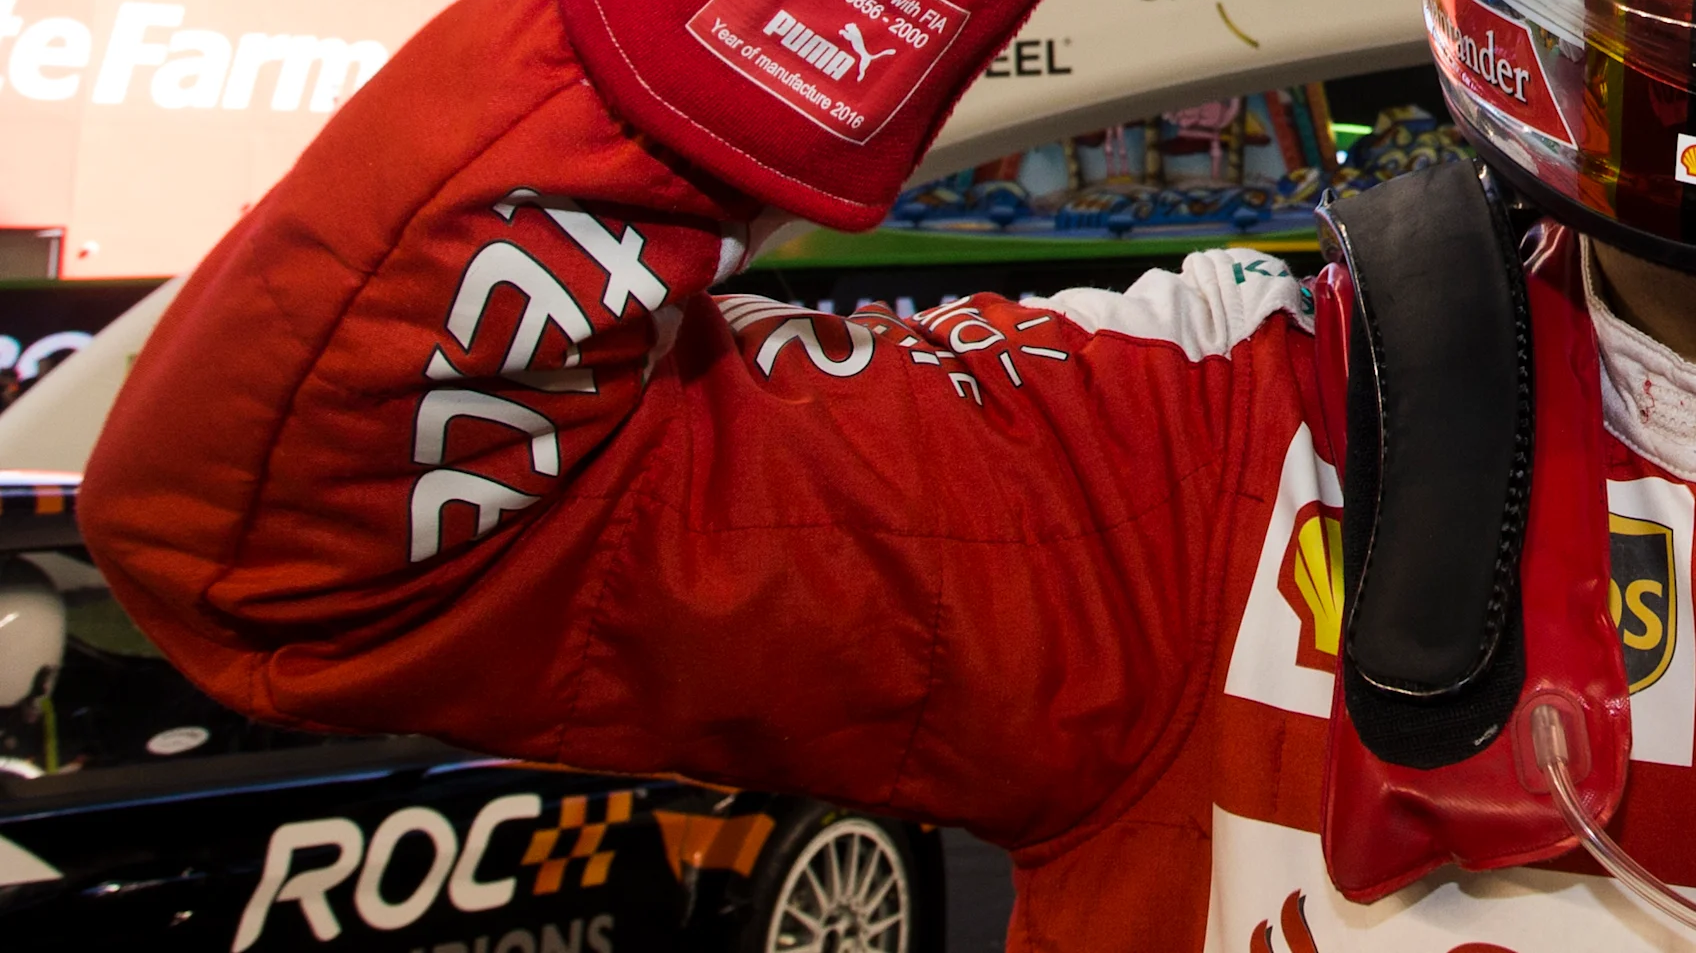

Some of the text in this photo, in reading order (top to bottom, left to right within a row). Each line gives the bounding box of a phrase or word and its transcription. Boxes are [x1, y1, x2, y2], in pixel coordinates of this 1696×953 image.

[763, 9, 856, 81] PUMA
[888, 20, 930, 49] 2000
[920, 9, 948, 34] FIA
[711, 18, 865, 130] Year of manufacture 2016
[232, 793, 541, 953] ROC
